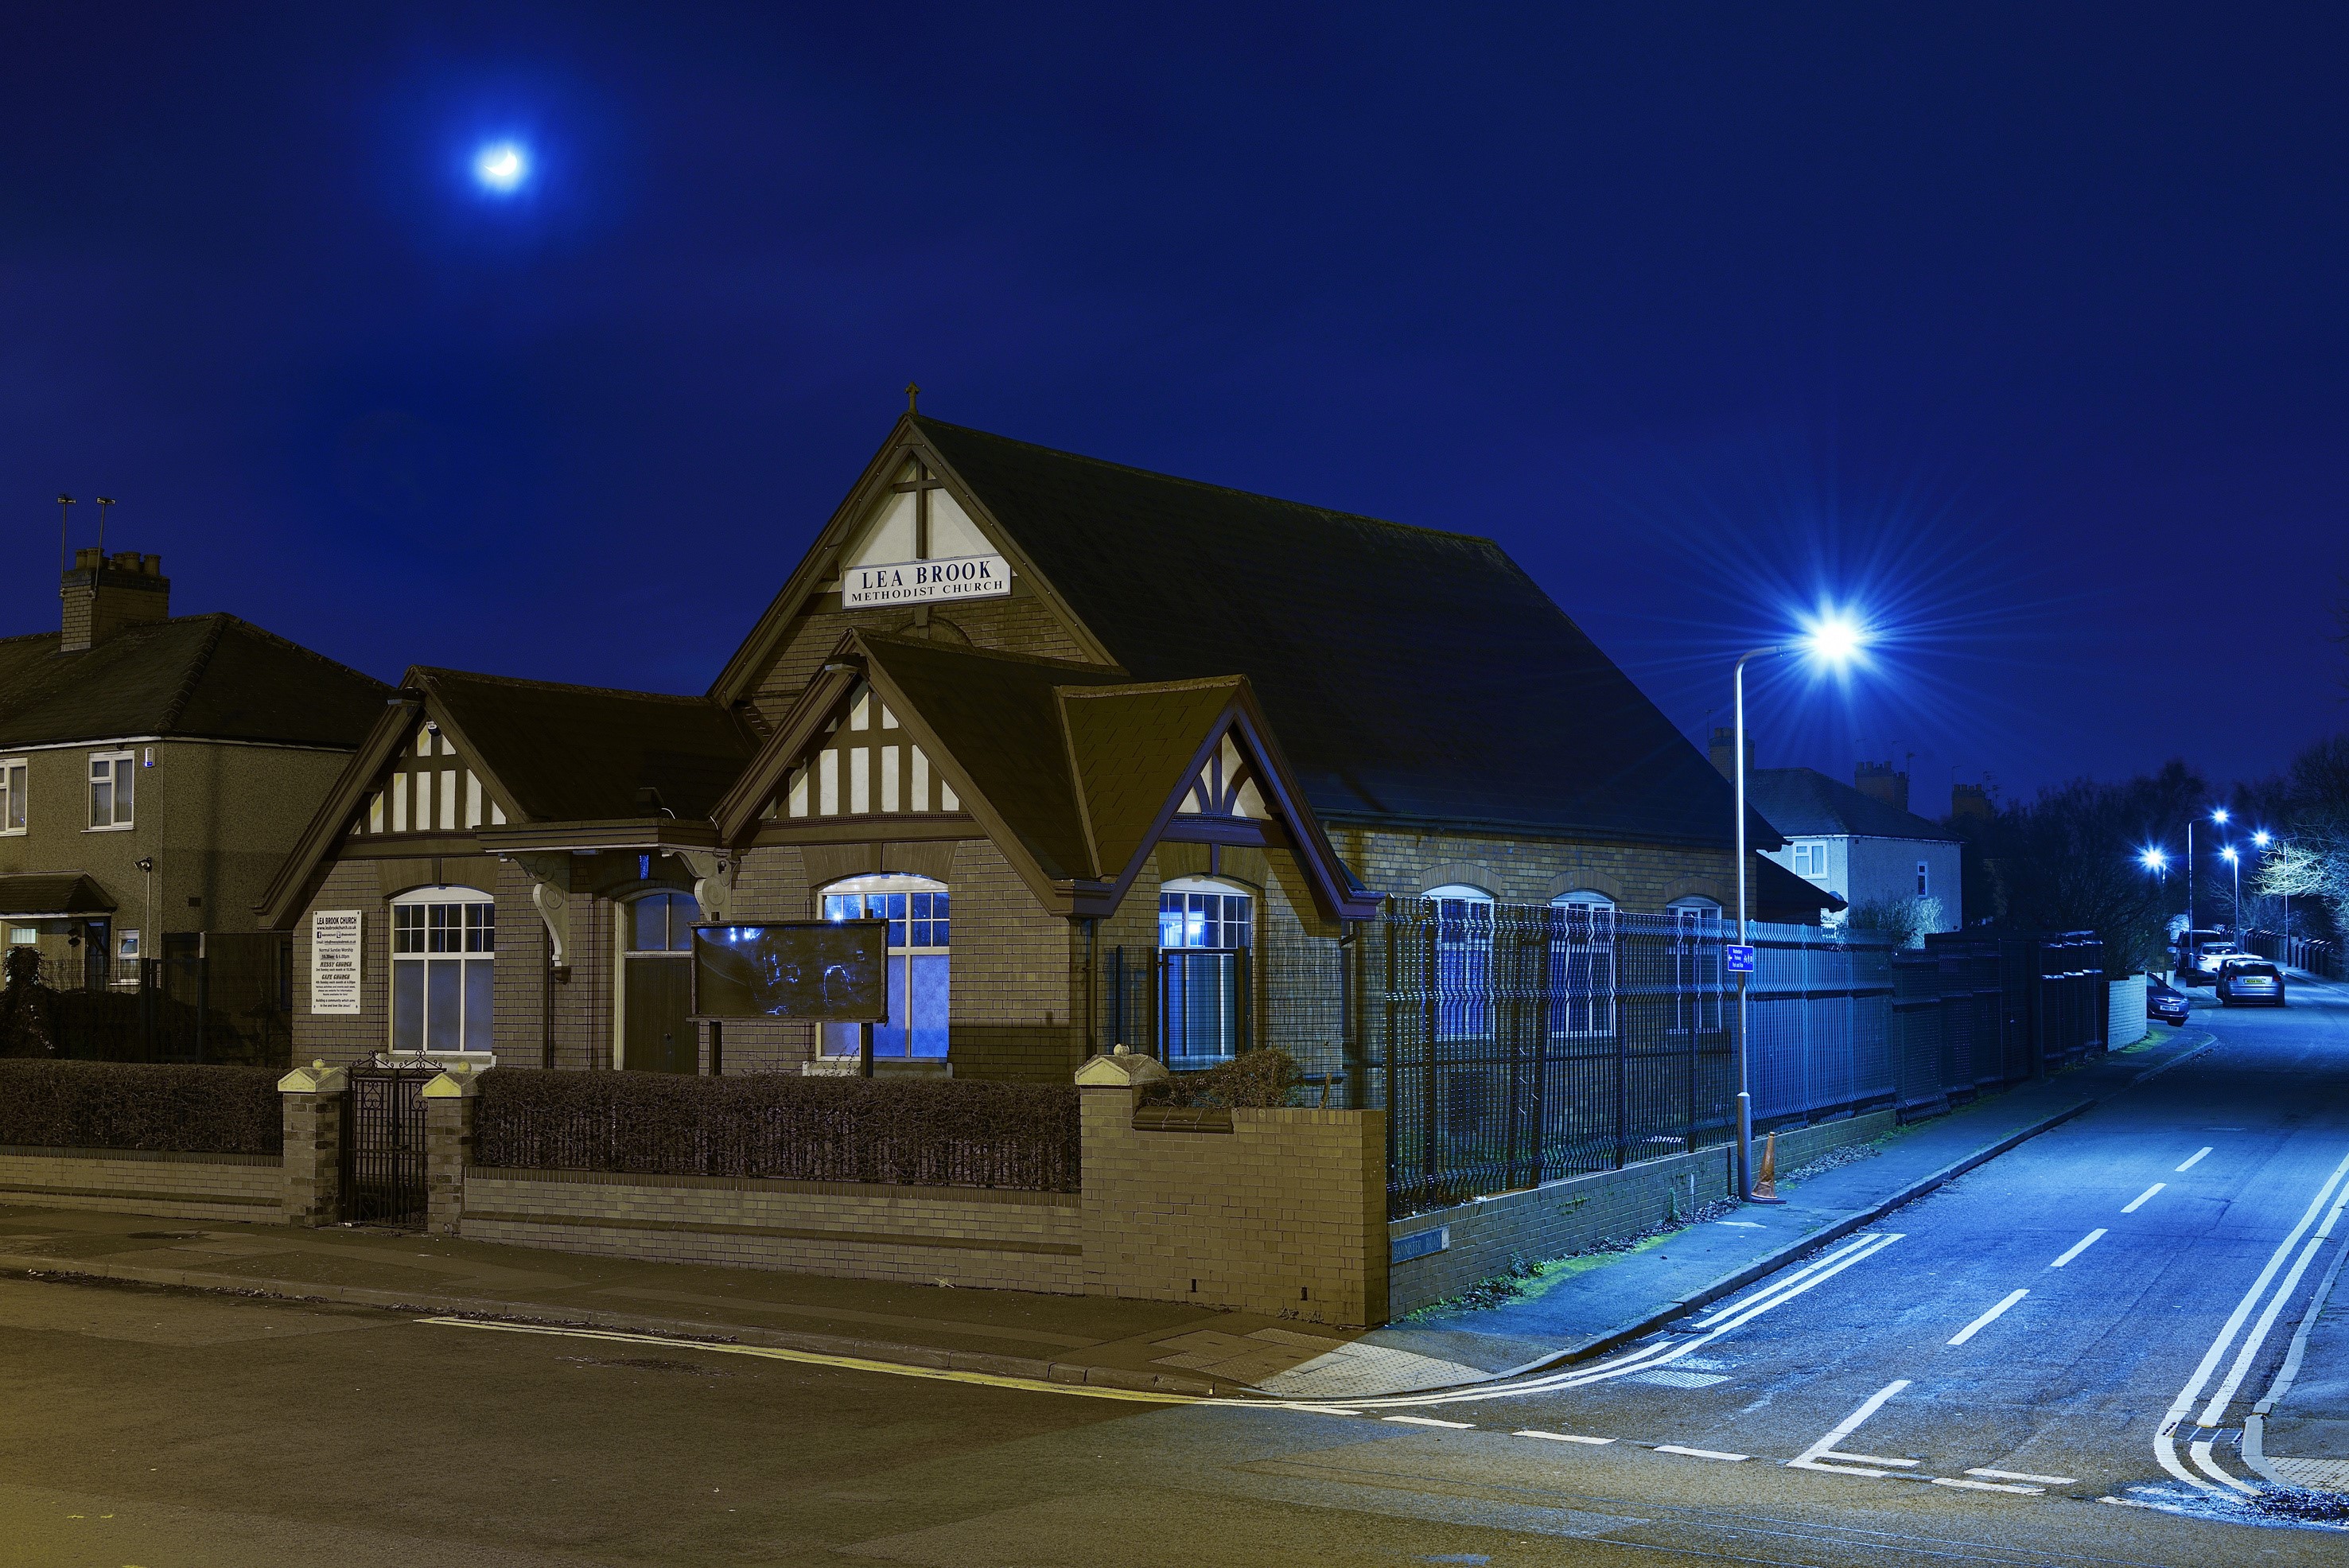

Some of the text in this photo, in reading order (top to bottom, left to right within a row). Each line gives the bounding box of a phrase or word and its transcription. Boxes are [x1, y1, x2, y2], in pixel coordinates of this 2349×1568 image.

[862, 560, 991, 589] LEA BROOK
[852, 580, 1003, 602] METHODIST CHURCH
[1394, 1235, 1440, 1259] BANNISTER ROAD
